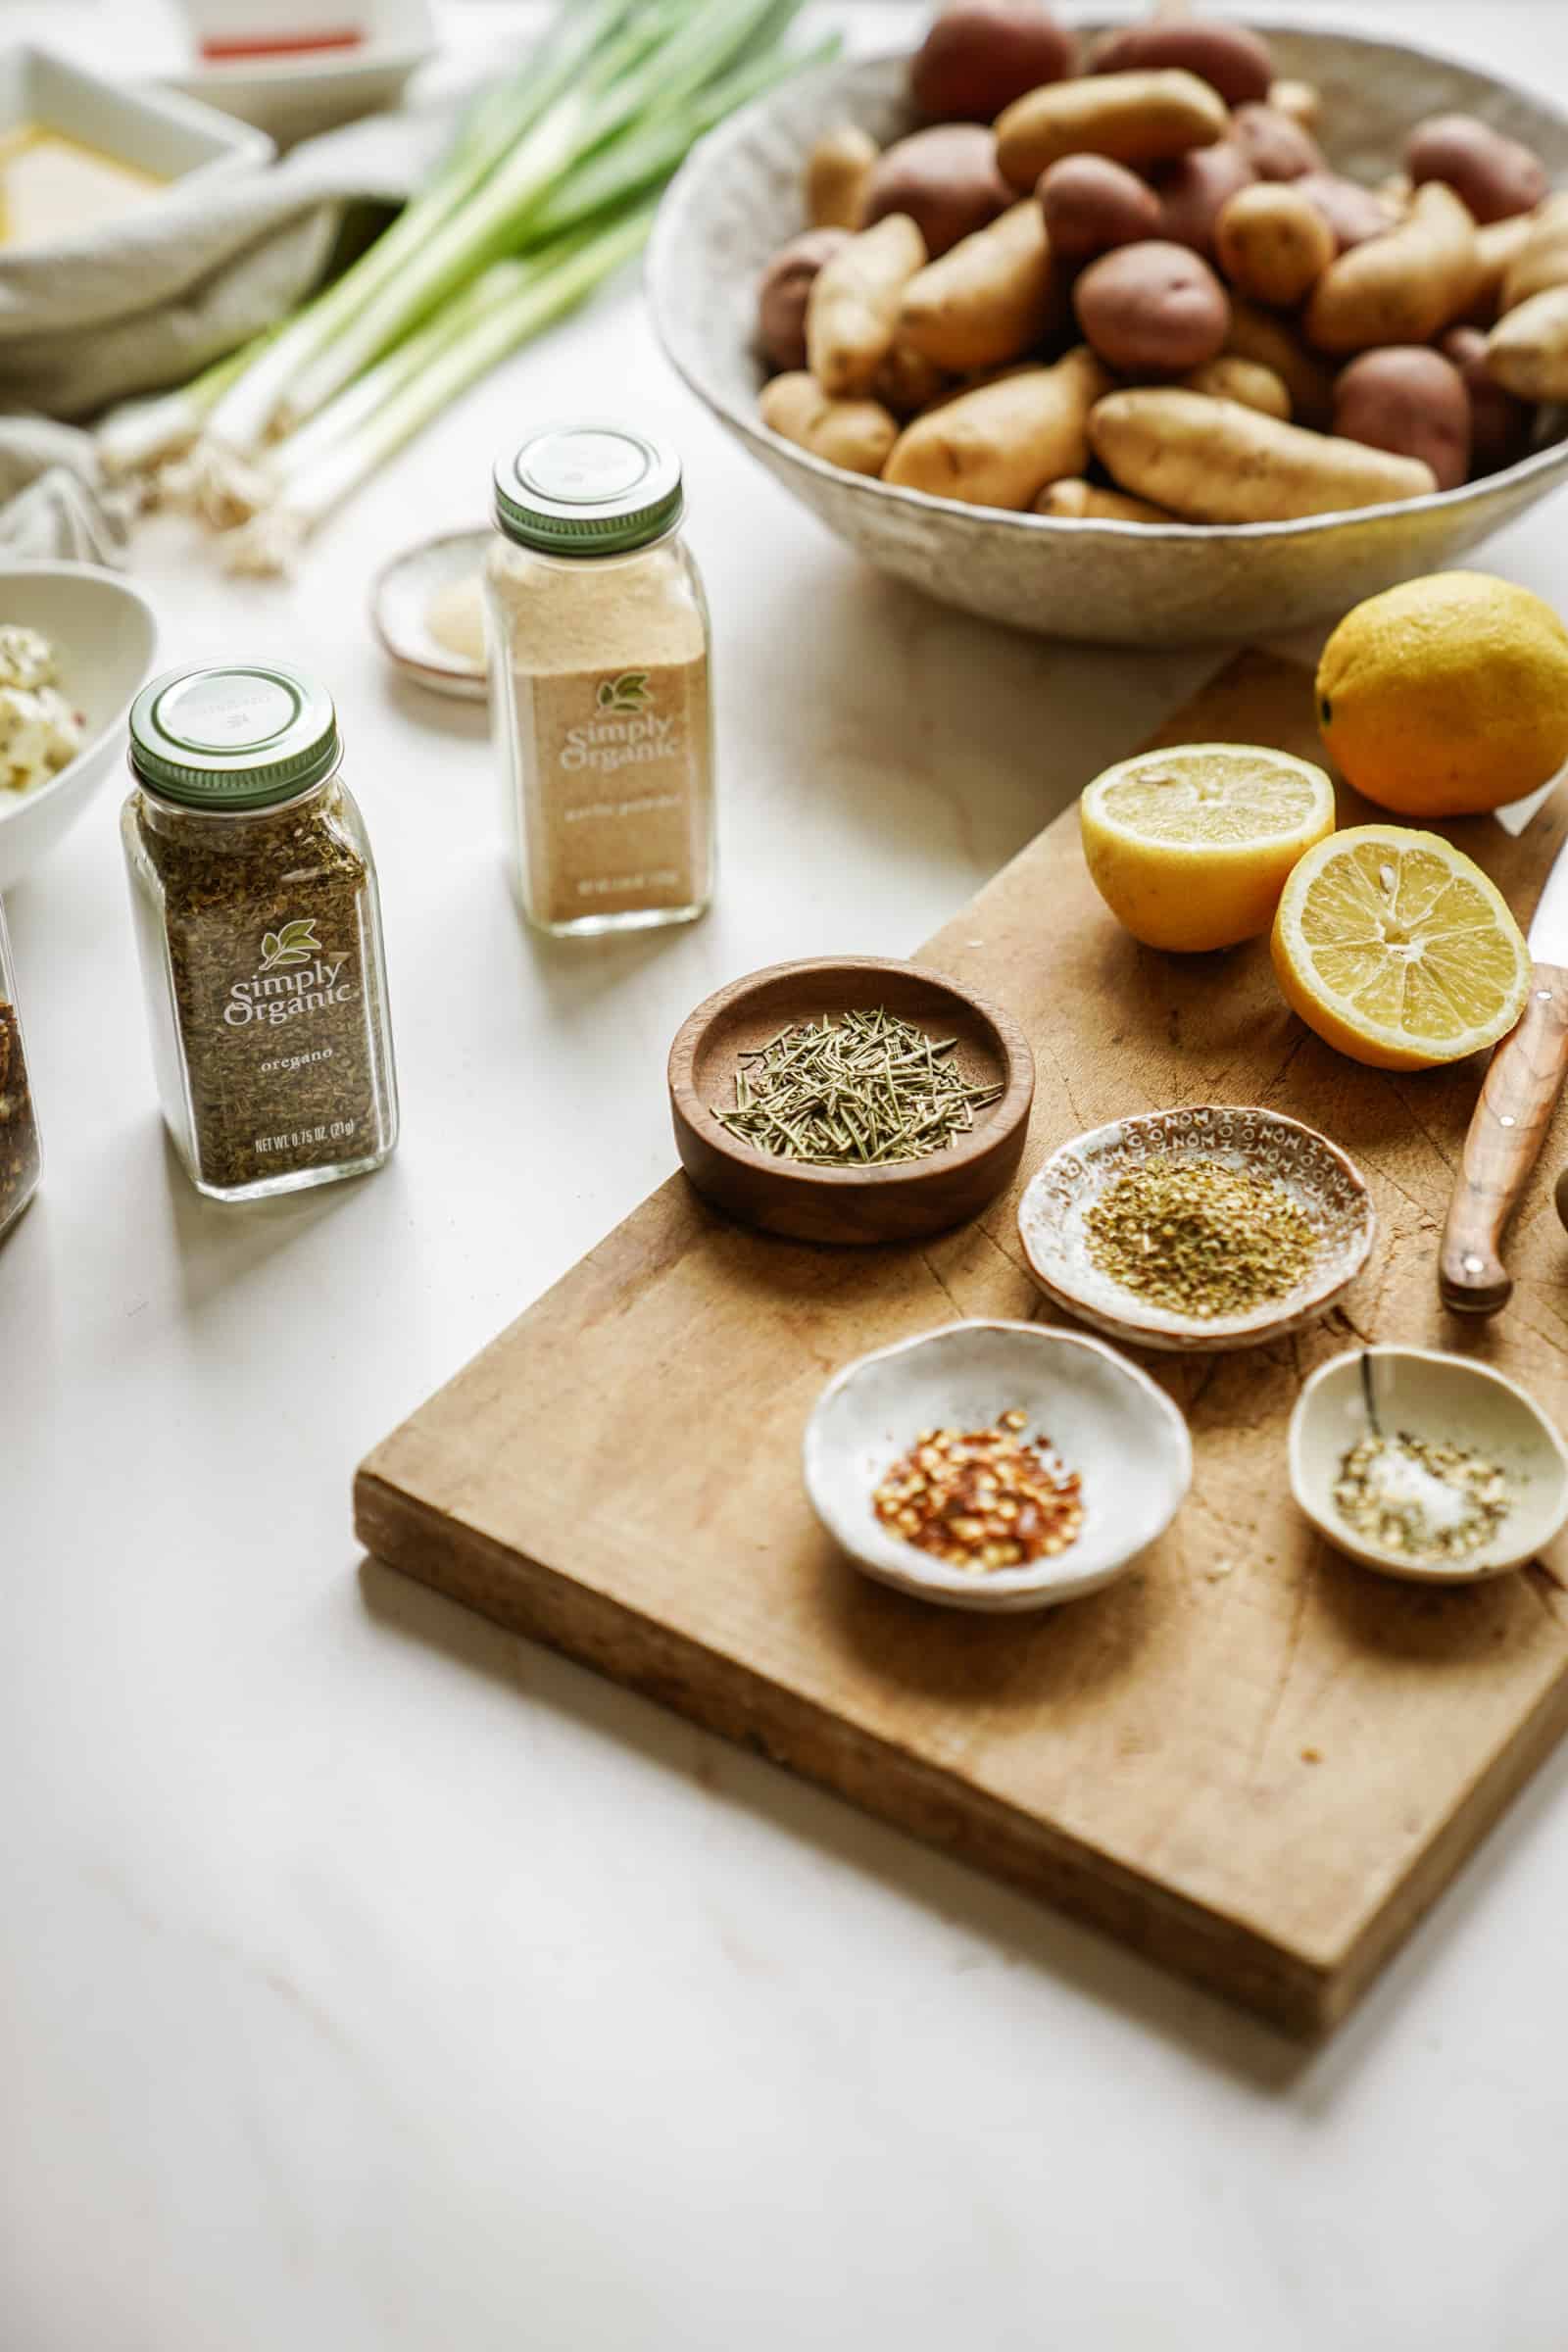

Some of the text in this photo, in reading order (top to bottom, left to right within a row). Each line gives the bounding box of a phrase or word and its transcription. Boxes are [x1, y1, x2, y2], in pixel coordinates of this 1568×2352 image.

[230, 959, 342, 1005] Simply
[223, 984, 352, 1026] Organic
[261, 1048, 333, 1072] oregano
[1164, 1110, 1208, 1129] NOM
[255, 1137, 272, 1153] NET
[291, 1129, 313, 1148] 0.75
[329, 1117, 354, 1139] (21g)
[1173, 1131, 1215, 1150] NOM
